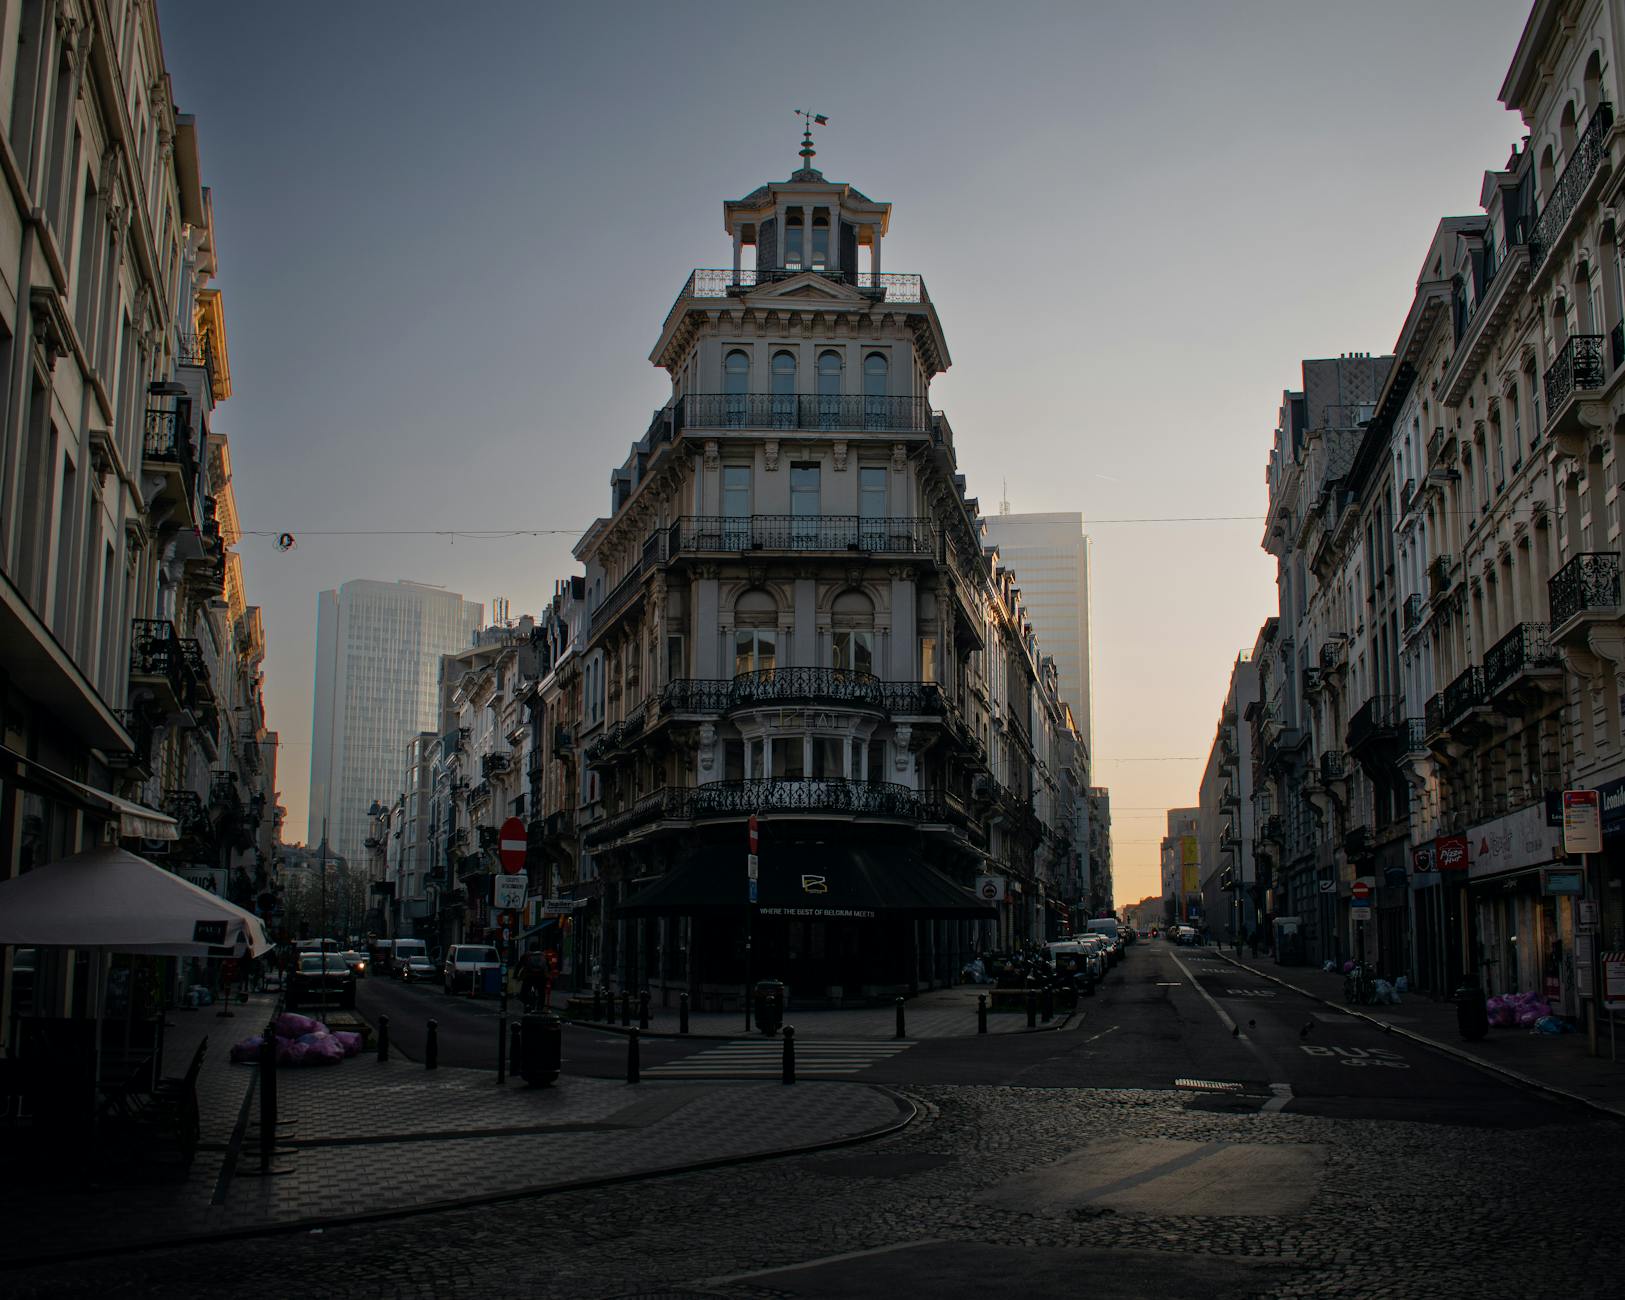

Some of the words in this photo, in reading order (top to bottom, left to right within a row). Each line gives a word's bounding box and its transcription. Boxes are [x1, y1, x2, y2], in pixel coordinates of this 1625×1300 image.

[1440, 848, 1464, 861] Pizza
[1445, 855, 1464, 866] Hut
[760, 907, 783, 916] WHERE
[784, 907, 797, 916] THE
[797, 908, 814, 916] BEST
[815, 908, 823, 917] OF
[824, 909, 853, 918] BELGIUM
[853, 910, 876, 919] MEETS
[1299, 1045, 1405, 1061] BUS
